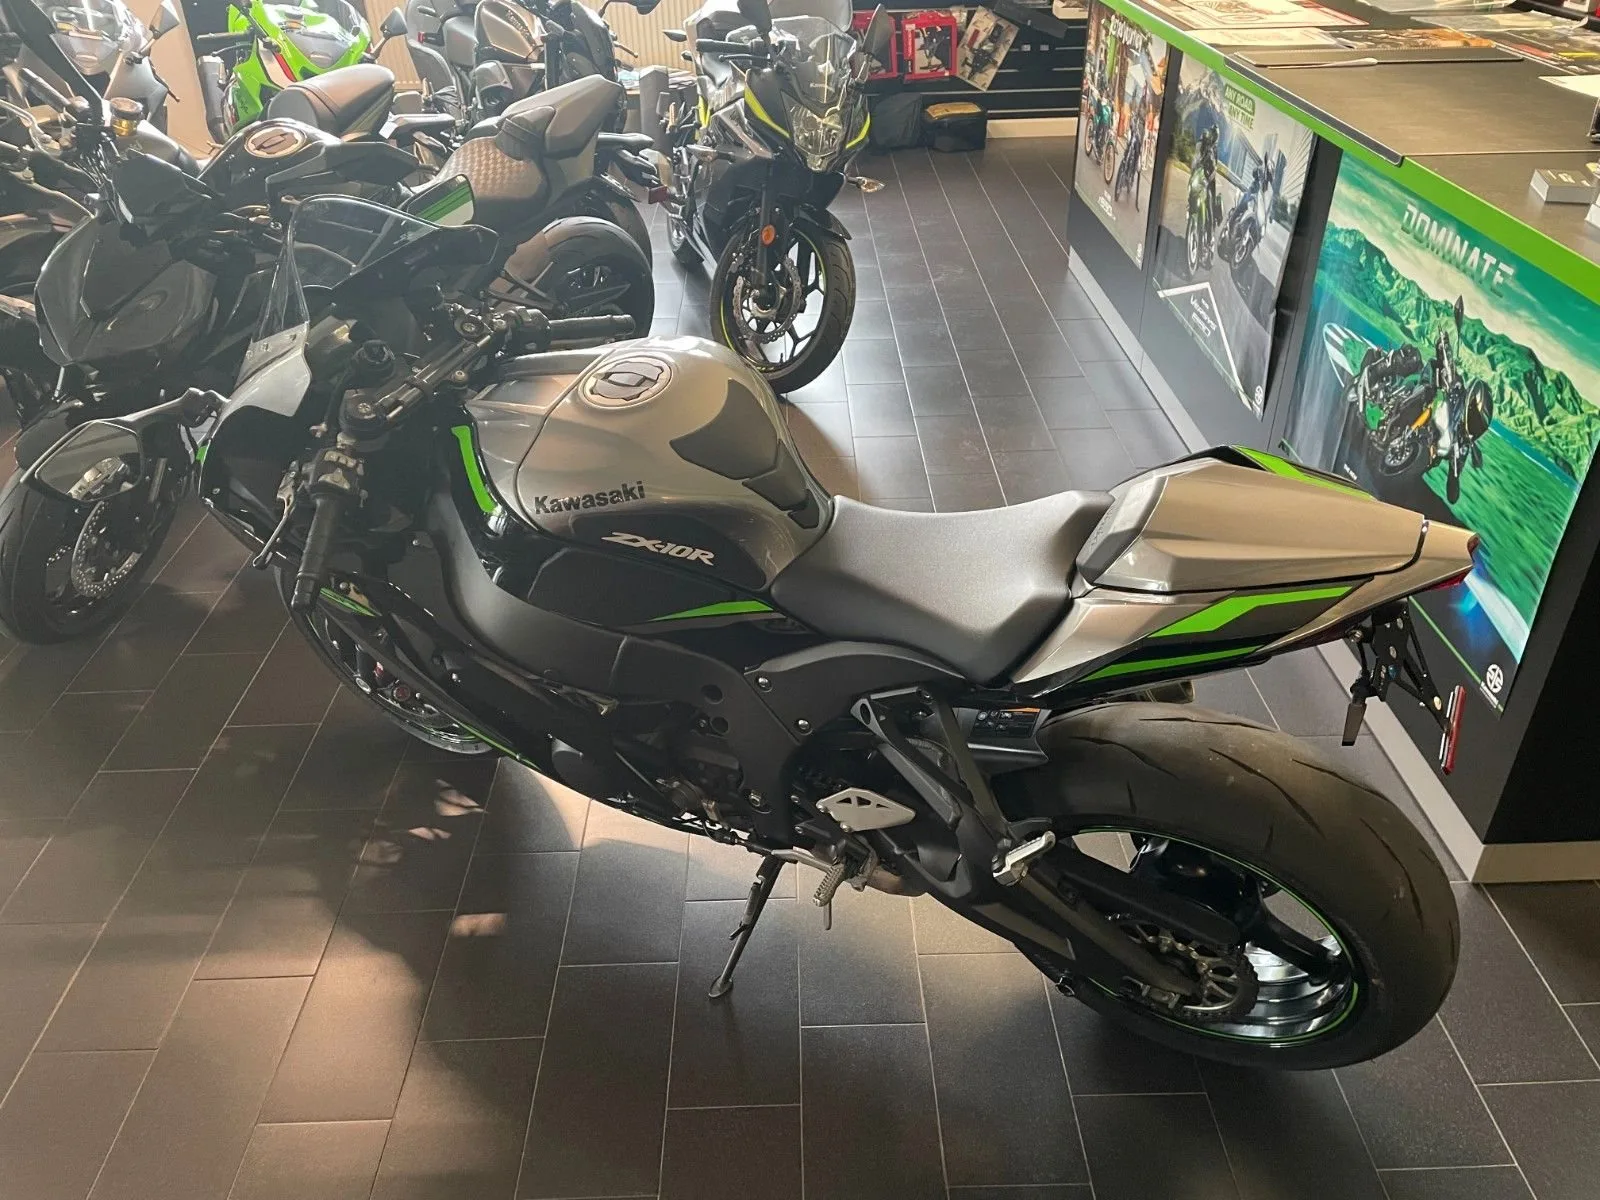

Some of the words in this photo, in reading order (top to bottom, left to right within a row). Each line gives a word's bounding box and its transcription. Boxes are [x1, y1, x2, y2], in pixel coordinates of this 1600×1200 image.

[1401, 203, 1515, 298] DOMINATE
[535, 481, 645, 514] Kawasaki
[601, 532, 714, 566] ZX-10R
